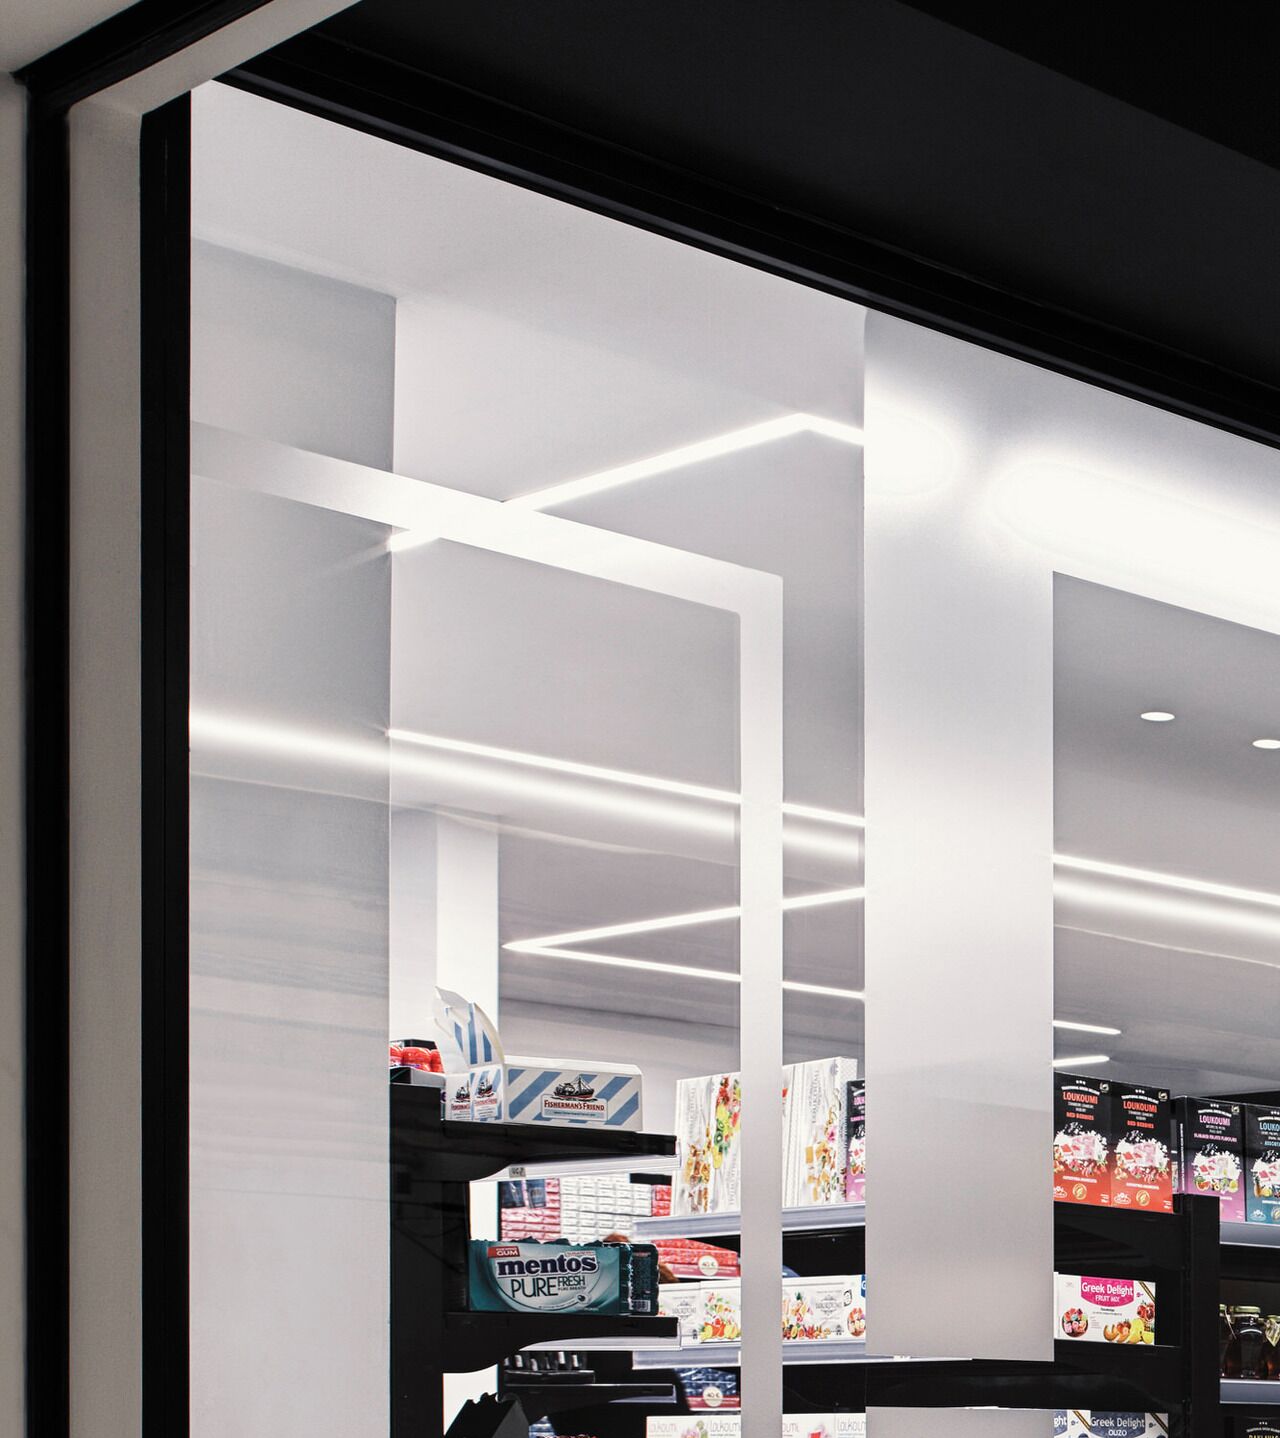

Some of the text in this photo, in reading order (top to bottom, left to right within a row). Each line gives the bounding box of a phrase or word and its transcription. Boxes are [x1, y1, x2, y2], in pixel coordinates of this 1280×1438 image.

[1063, 1091, 1098, 1104] LOUKOUMI
[544, 1100, 605, 1111] FISHERMAN'S FRIEND
[1123, 1101, 1158, 1113] LOUKOUMI
[1200, 1115, 1231, 1126] LOUKOUMI
[497, 1254, 597, 1276] mentos
[558, 1276, 586, 1286] FRESH
[511, 1278, 558, 1298] PURE
[1082, 1282, 1133, 1297] Greek Delight
[1091, 1417, 1145, 1430] Greek Delight
